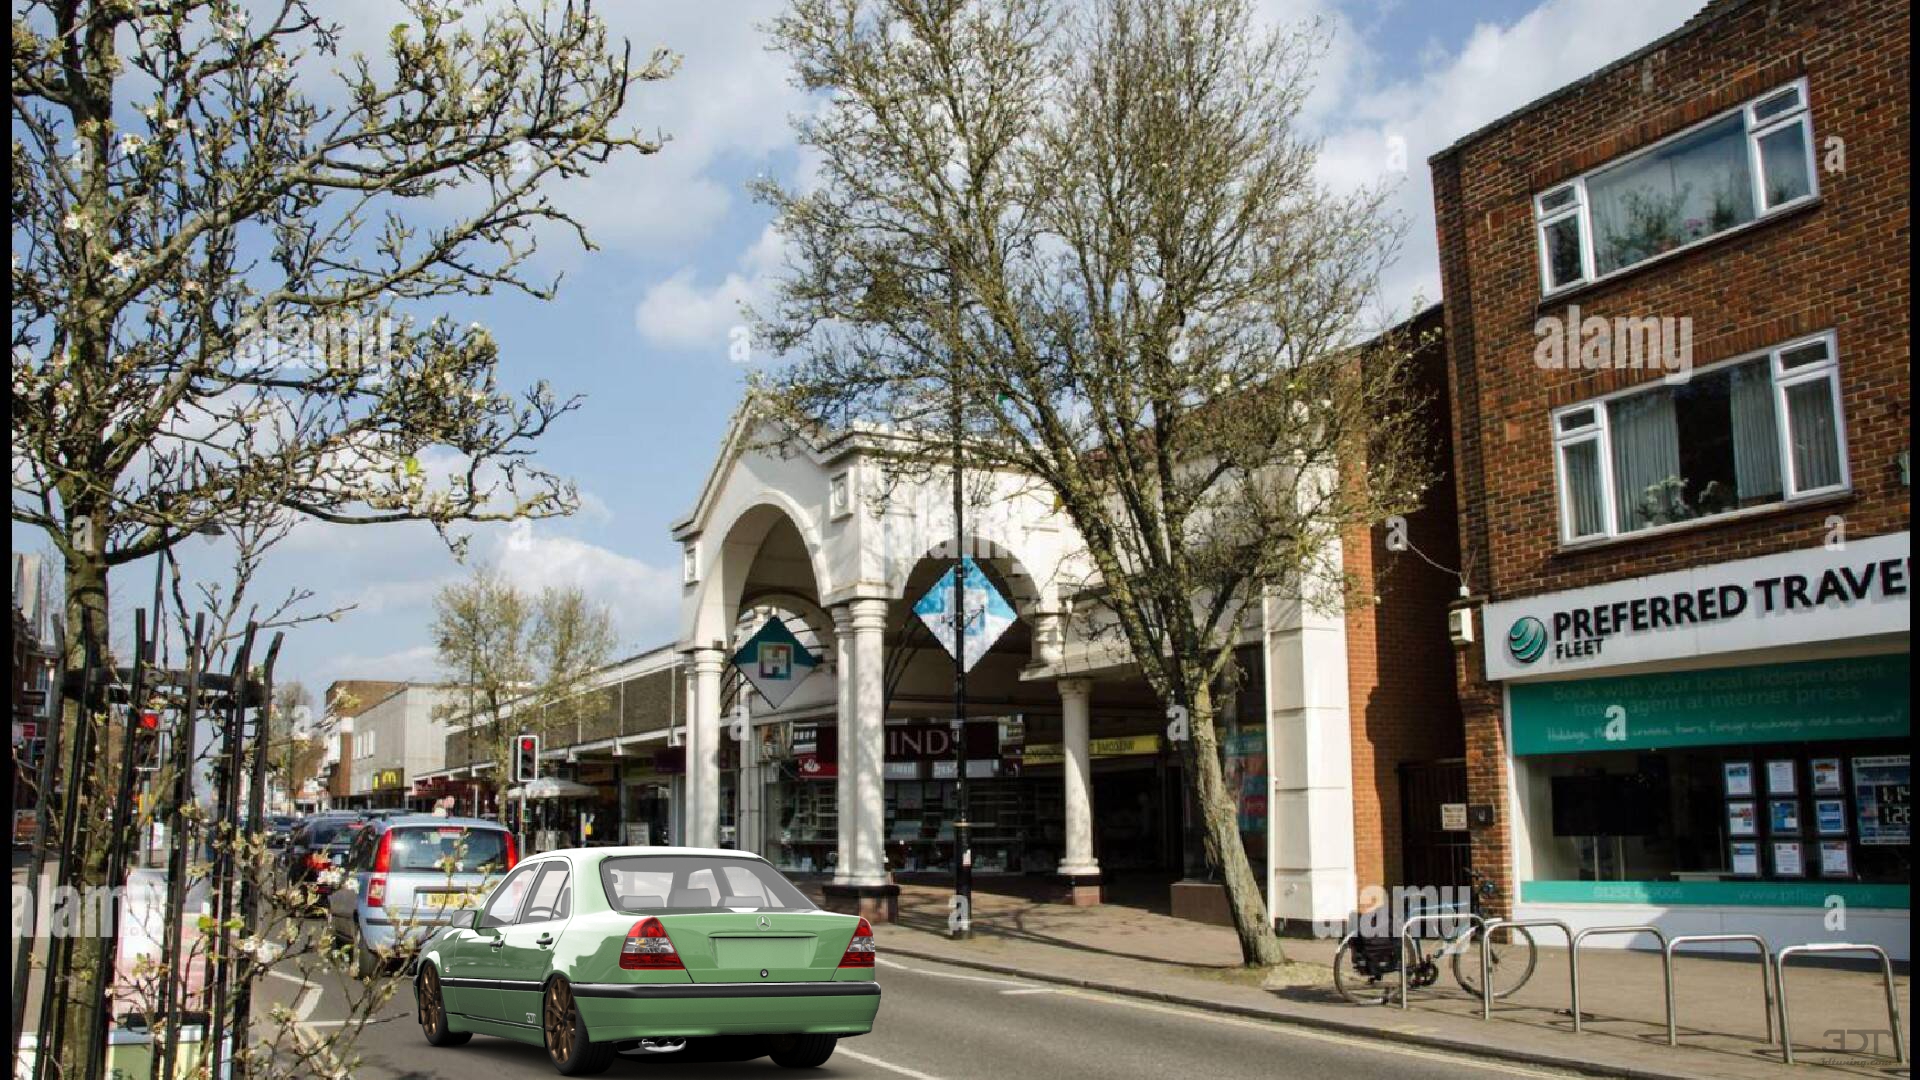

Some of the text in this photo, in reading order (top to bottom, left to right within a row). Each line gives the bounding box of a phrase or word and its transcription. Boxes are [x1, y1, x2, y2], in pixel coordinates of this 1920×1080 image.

[1553, 557, 1910, 641] PREFERRED TRAVE
[1556, 638, 1604, 659] FLEET
